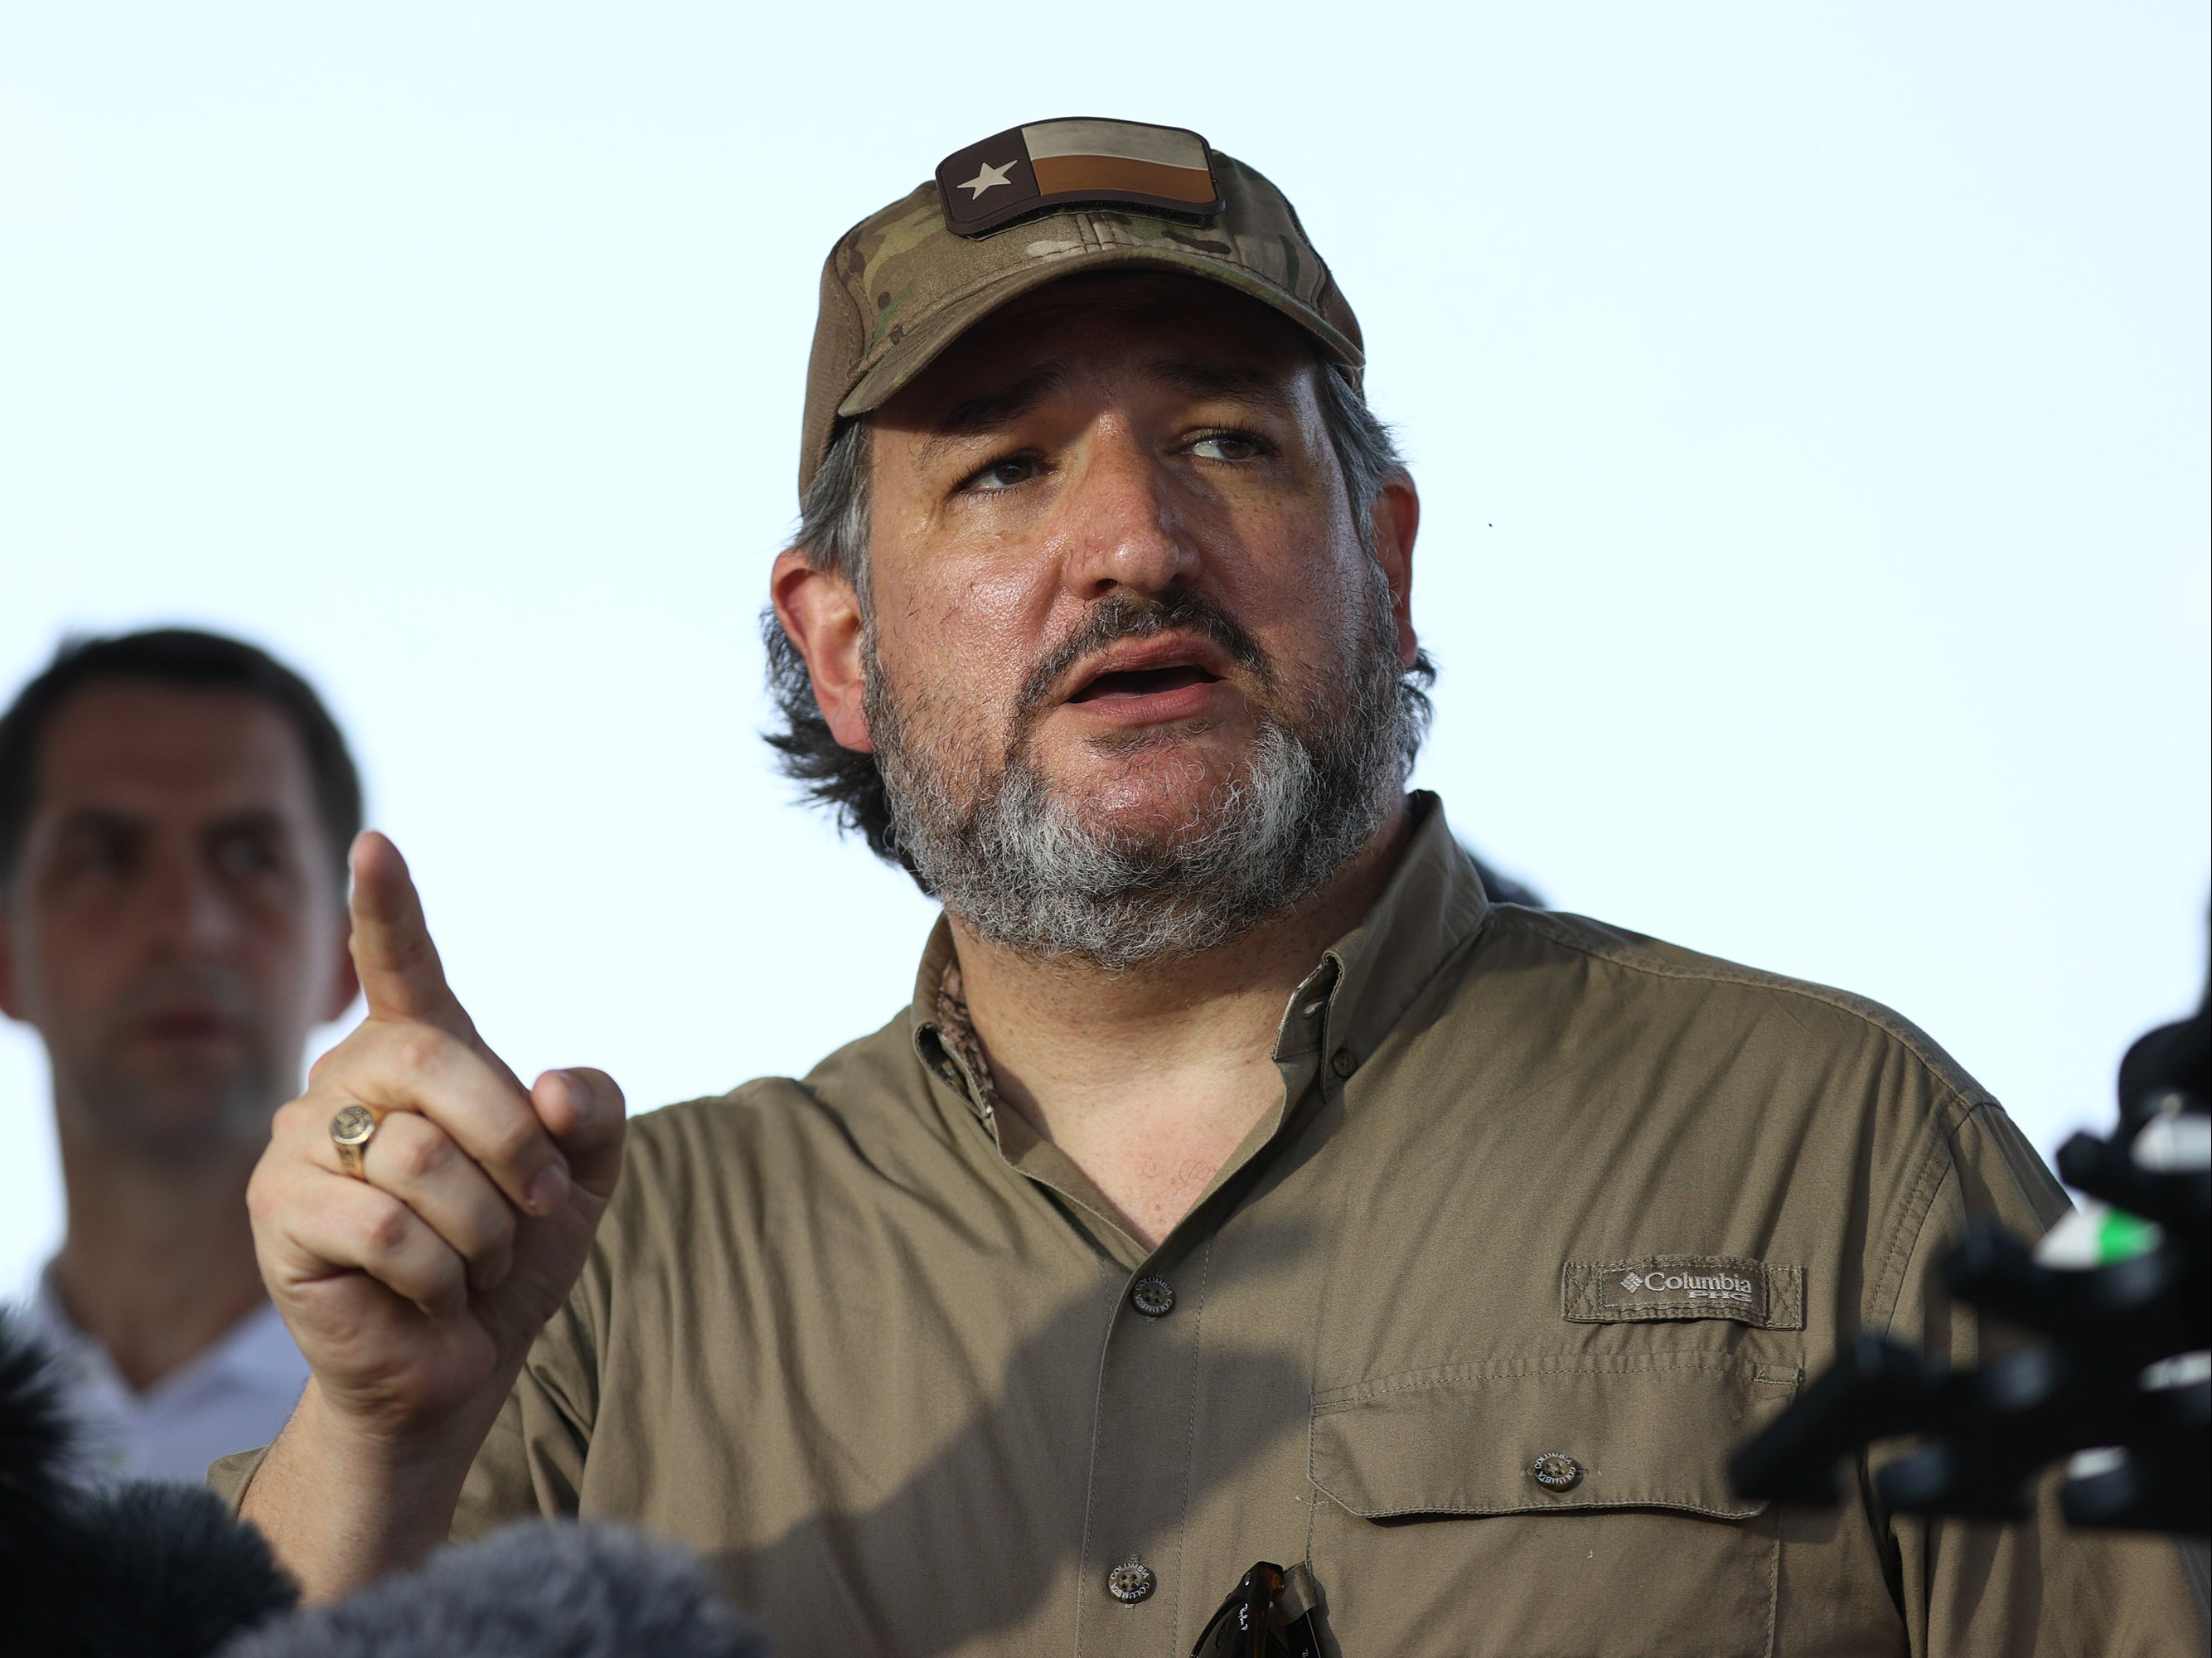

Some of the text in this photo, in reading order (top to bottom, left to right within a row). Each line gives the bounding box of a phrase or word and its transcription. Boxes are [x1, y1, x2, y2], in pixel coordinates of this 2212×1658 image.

[1643, 1271, 1752, 1294] Columbia
[1533, 1452, 1572, 1469] COLUMBIA
[1537, 1467, 1576, 1484] COLUMBIA
[1110, 1563, 1150, 1580] COLUMBIA
[1110, 1582, 1150, 1600] COLUMBIA
